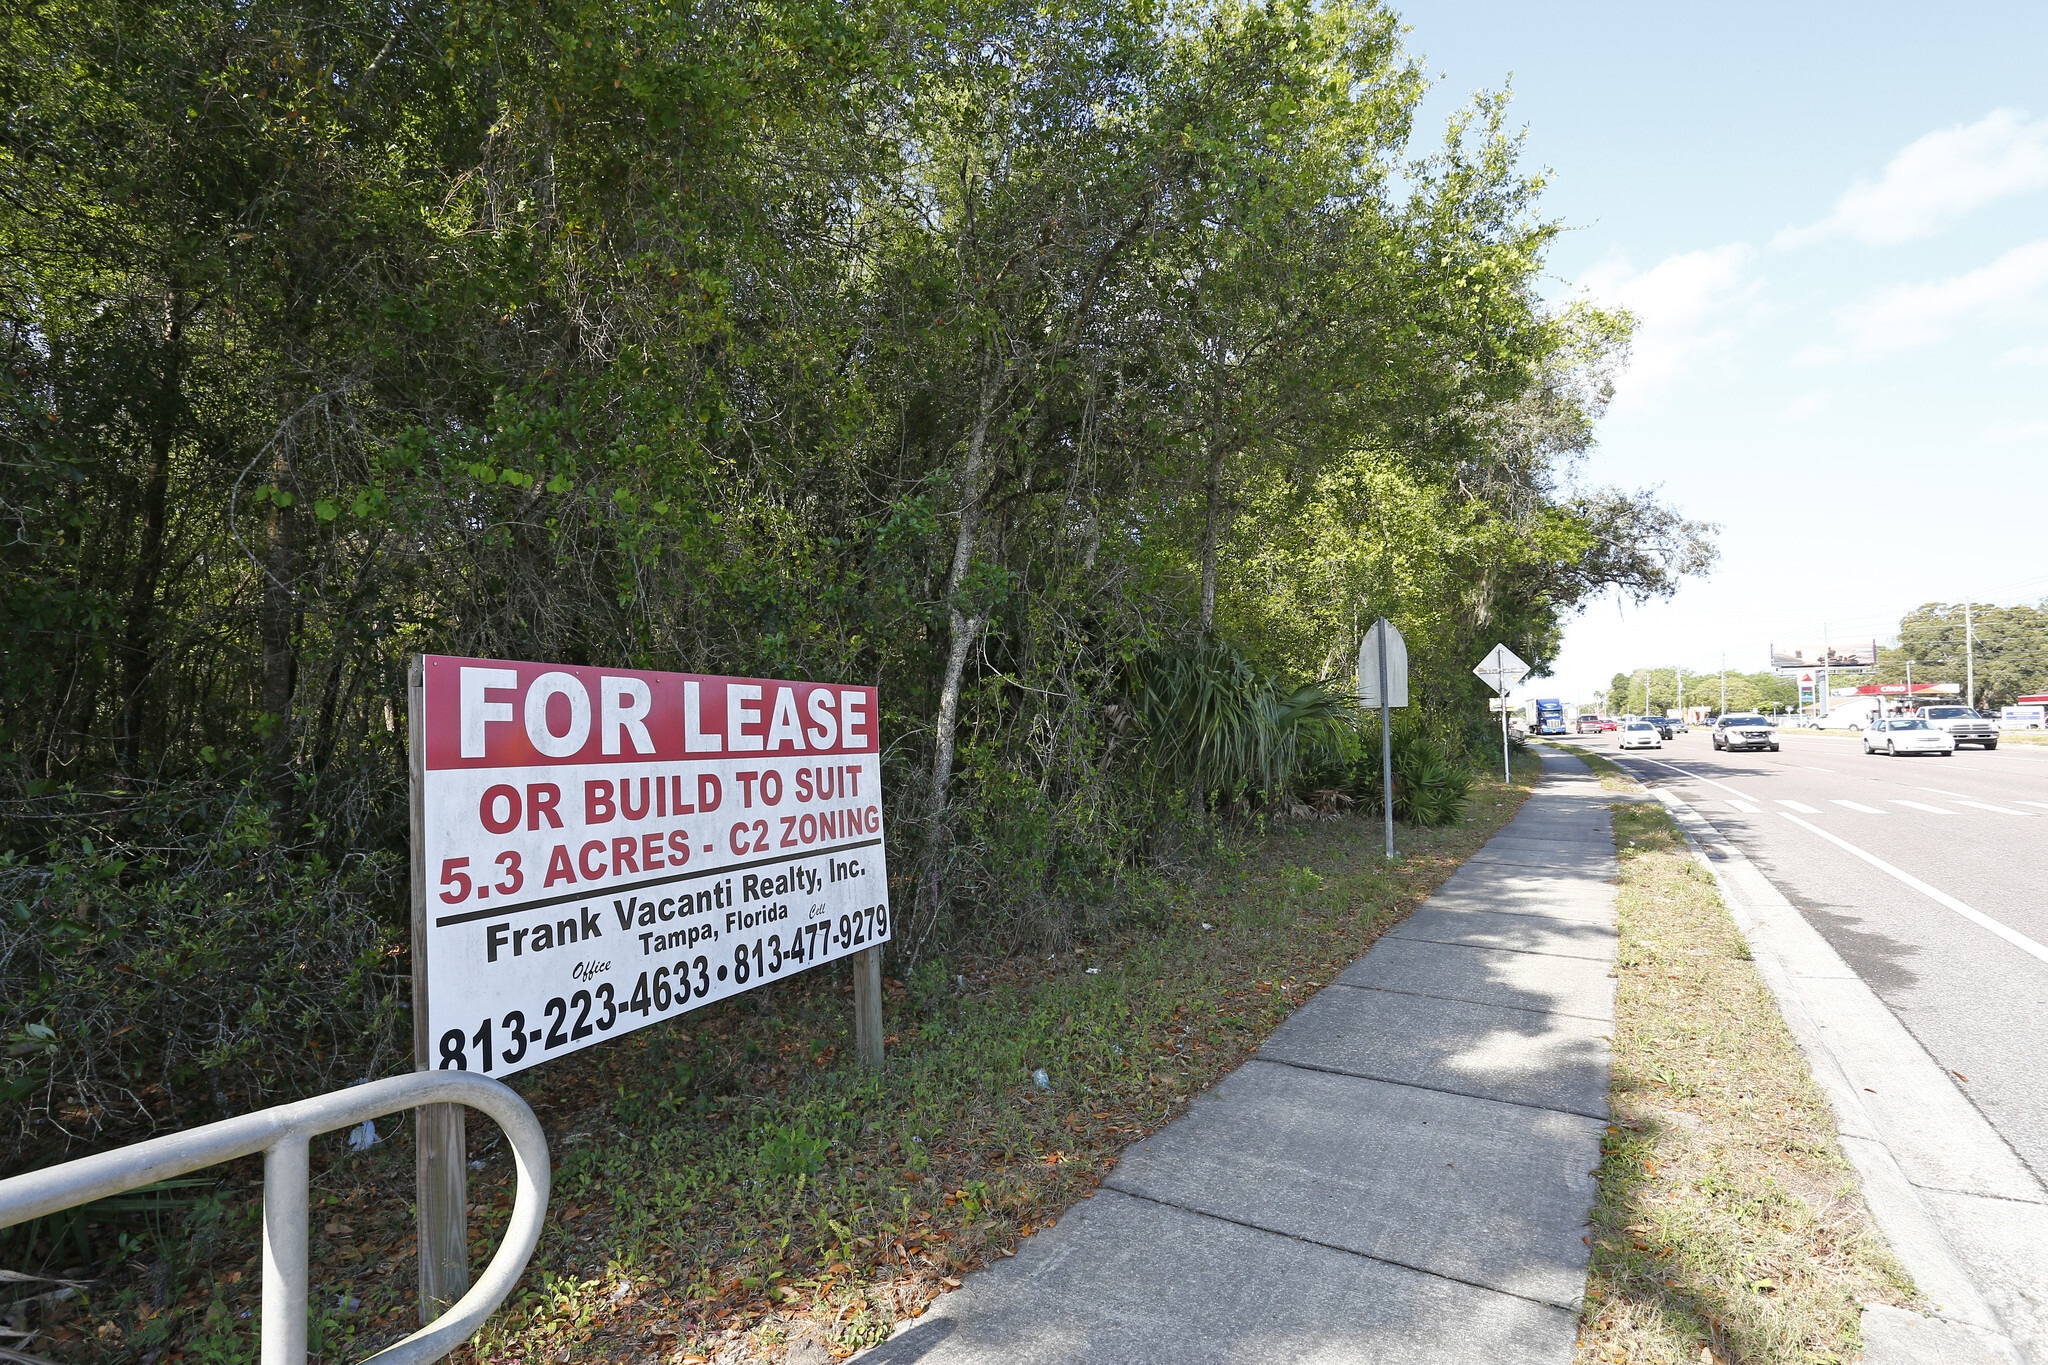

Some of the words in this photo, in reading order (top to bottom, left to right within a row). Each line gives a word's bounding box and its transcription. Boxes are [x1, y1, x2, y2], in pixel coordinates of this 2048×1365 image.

[460, 667, 656, 759] FOR
[683, 681, 868, 753] LEASE
[479, 782, 563, 834] OR
[584, 773, 722, 825] BUILD
[736, 770, 783, 809] TO
[795, 765, 863, 801] SUIT
[439, 850, 524, 905] 5.3
[543, 829, 690, 888] ACRES
[729, 819, 769, 856] C2
[780, 805, 880, 847] ZONING
[486, 907, 602, 963] Frank
[613, 878, 732, 931] Vacanti
[742, 865, 822, 903] Realty,
[829, 858, 866, 883] Inc.
[638, 923, 719, 956] Tampa,
[726, 902, 788, 934] Florida
[809, 903, 826, 919] Cell
[438, 955, 710, 1073] 813-223-4633
[734, 903, 887, 985] 813-477-9279
[572, 960, 612, 982] Office
